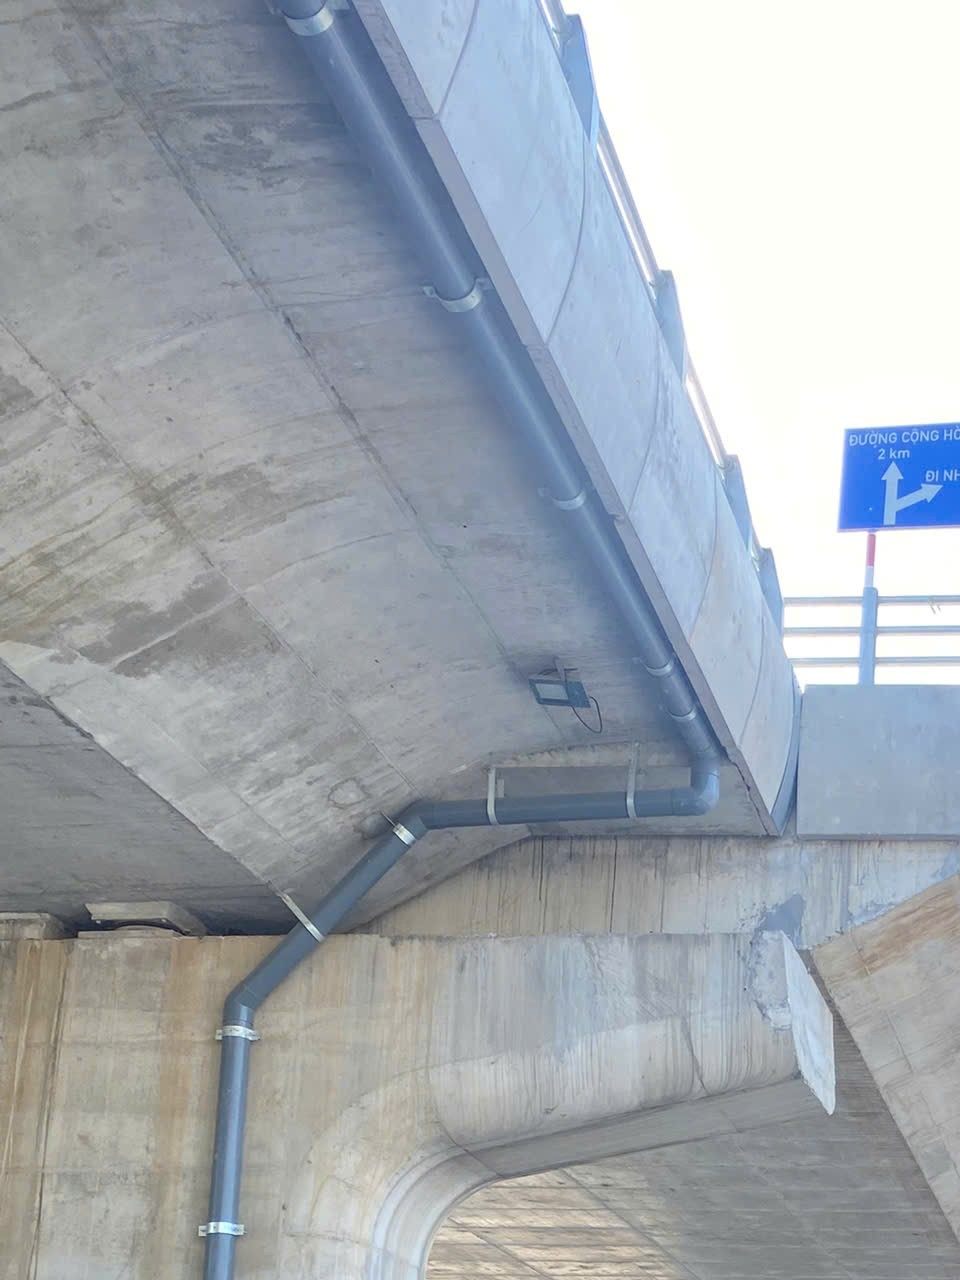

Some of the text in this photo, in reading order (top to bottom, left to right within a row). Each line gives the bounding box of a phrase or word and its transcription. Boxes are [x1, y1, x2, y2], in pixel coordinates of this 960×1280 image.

[901, 428, 940, 445] CỘNG
[877, 447, 910, 460] 2 km
[925, 469, 939, 482] ĐI
